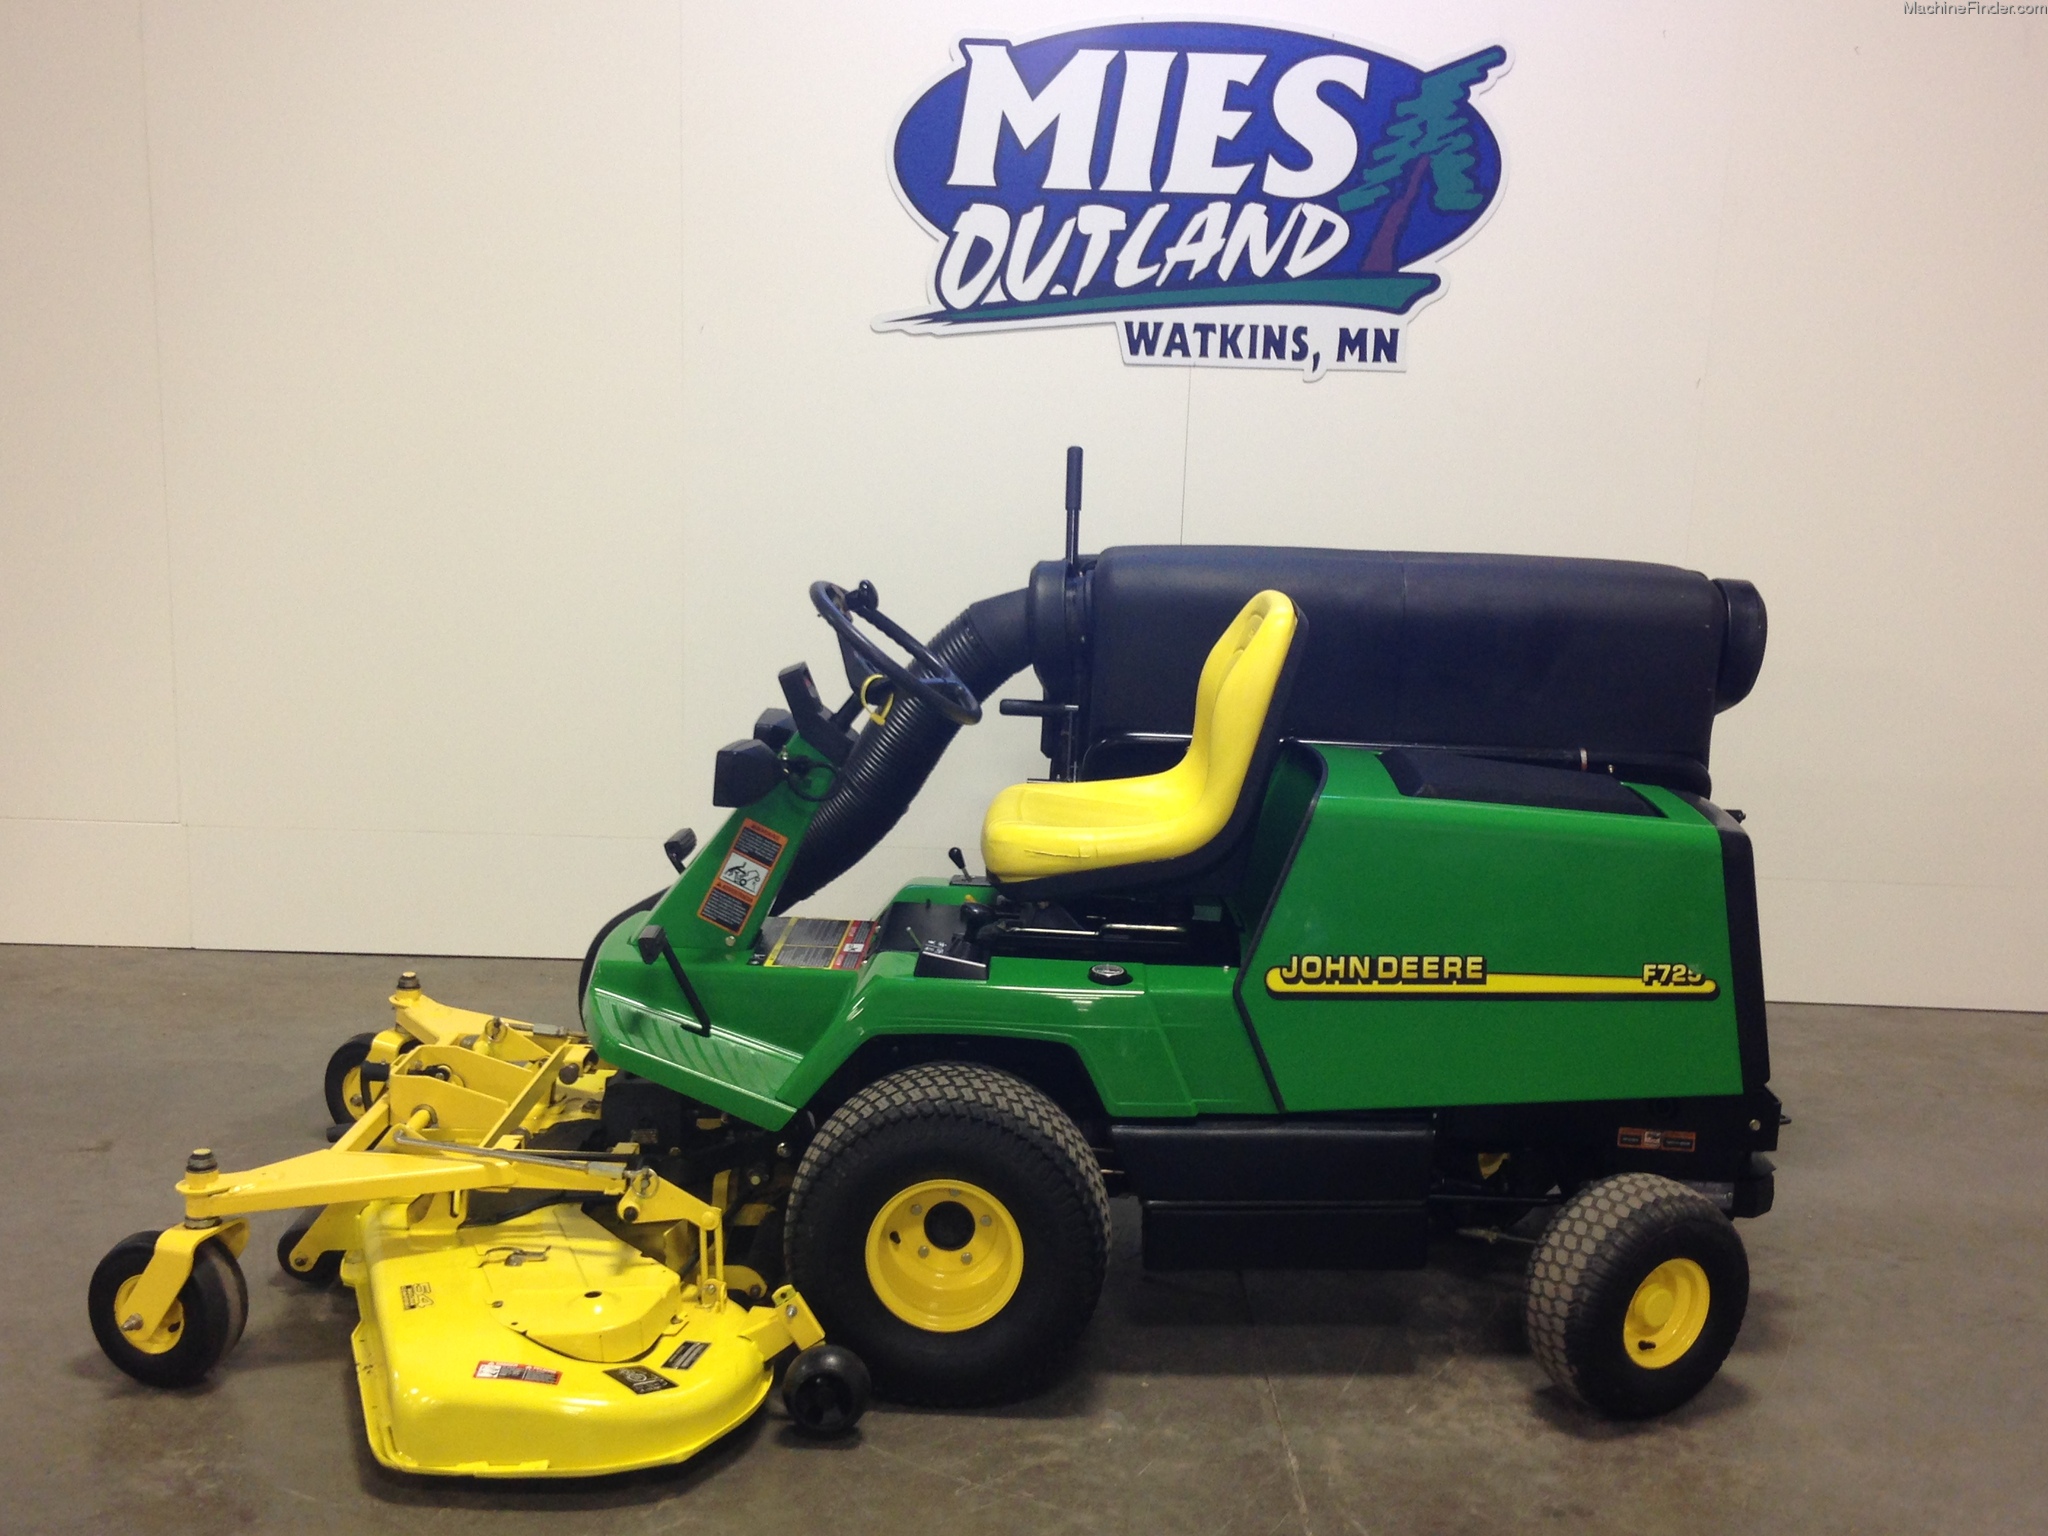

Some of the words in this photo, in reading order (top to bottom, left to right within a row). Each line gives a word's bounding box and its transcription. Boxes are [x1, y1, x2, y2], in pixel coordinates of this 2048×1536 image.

[945, 43, 1371, 198] MIES
[1124, 321, 1321, 372] WATKINS,
[1336, 327, 1401, 363] MN
[1281, 955, 1370, 982] JOHN
[1377, 955, 1485, 982] DEERE
